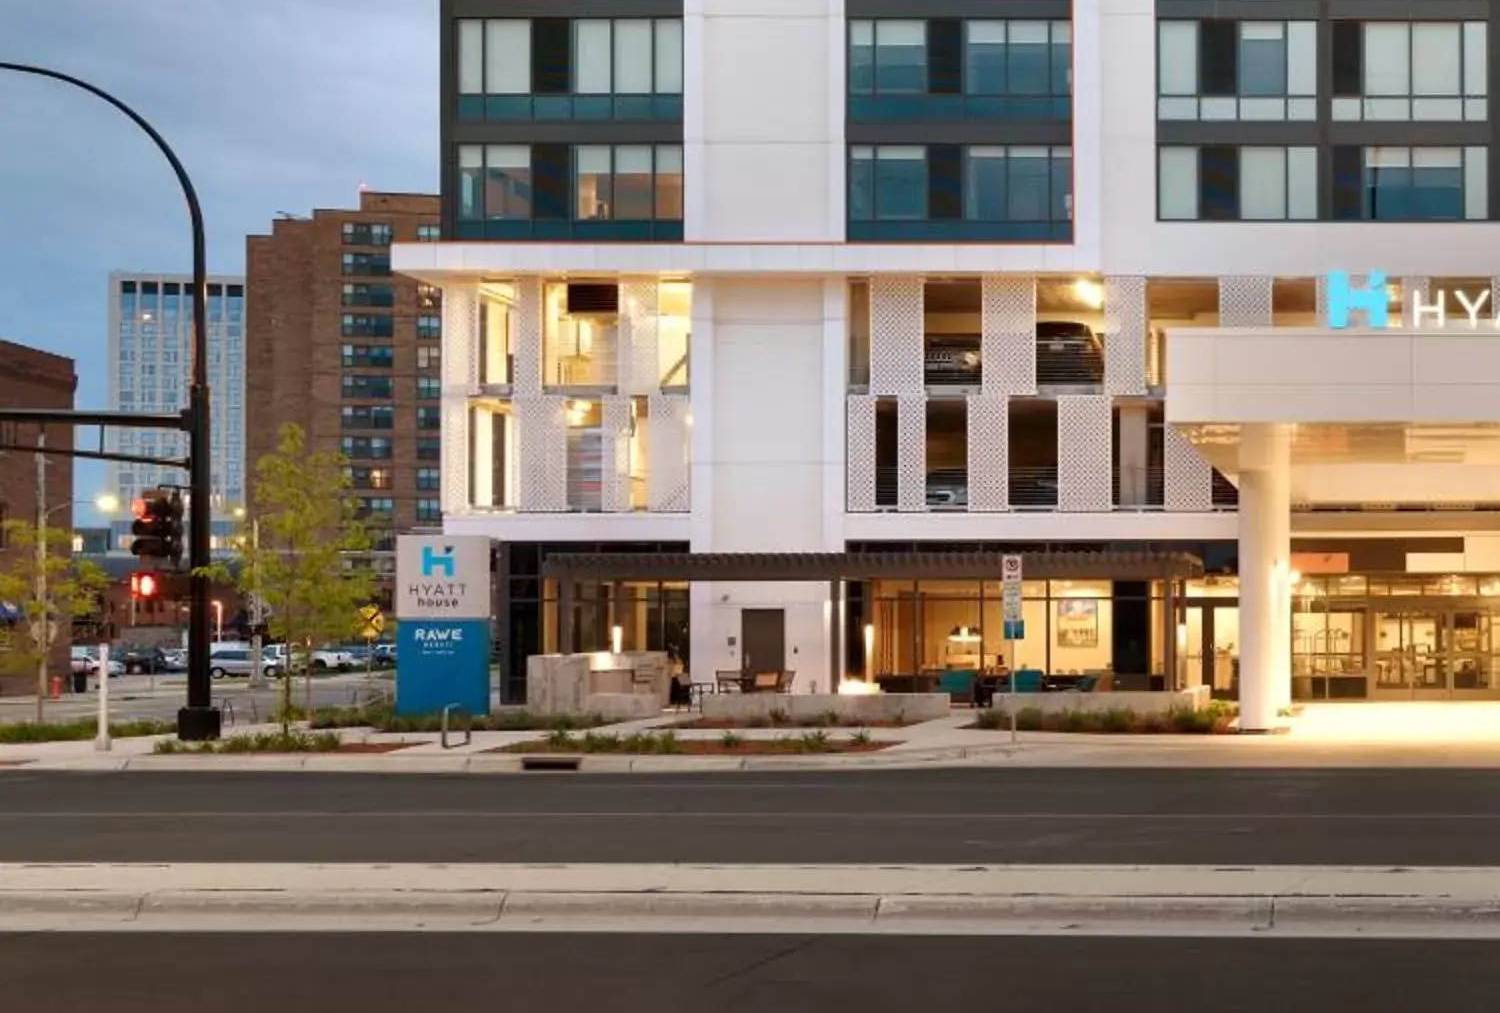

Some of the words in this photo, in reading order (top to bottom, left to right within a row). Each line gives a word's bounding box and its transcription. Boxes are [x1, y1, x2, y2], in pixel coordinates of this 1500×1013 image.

[408, 583, 467, 597] HYATT
[417, 597, 459, 608] house
[414, 627, 464, 641] RAWE
